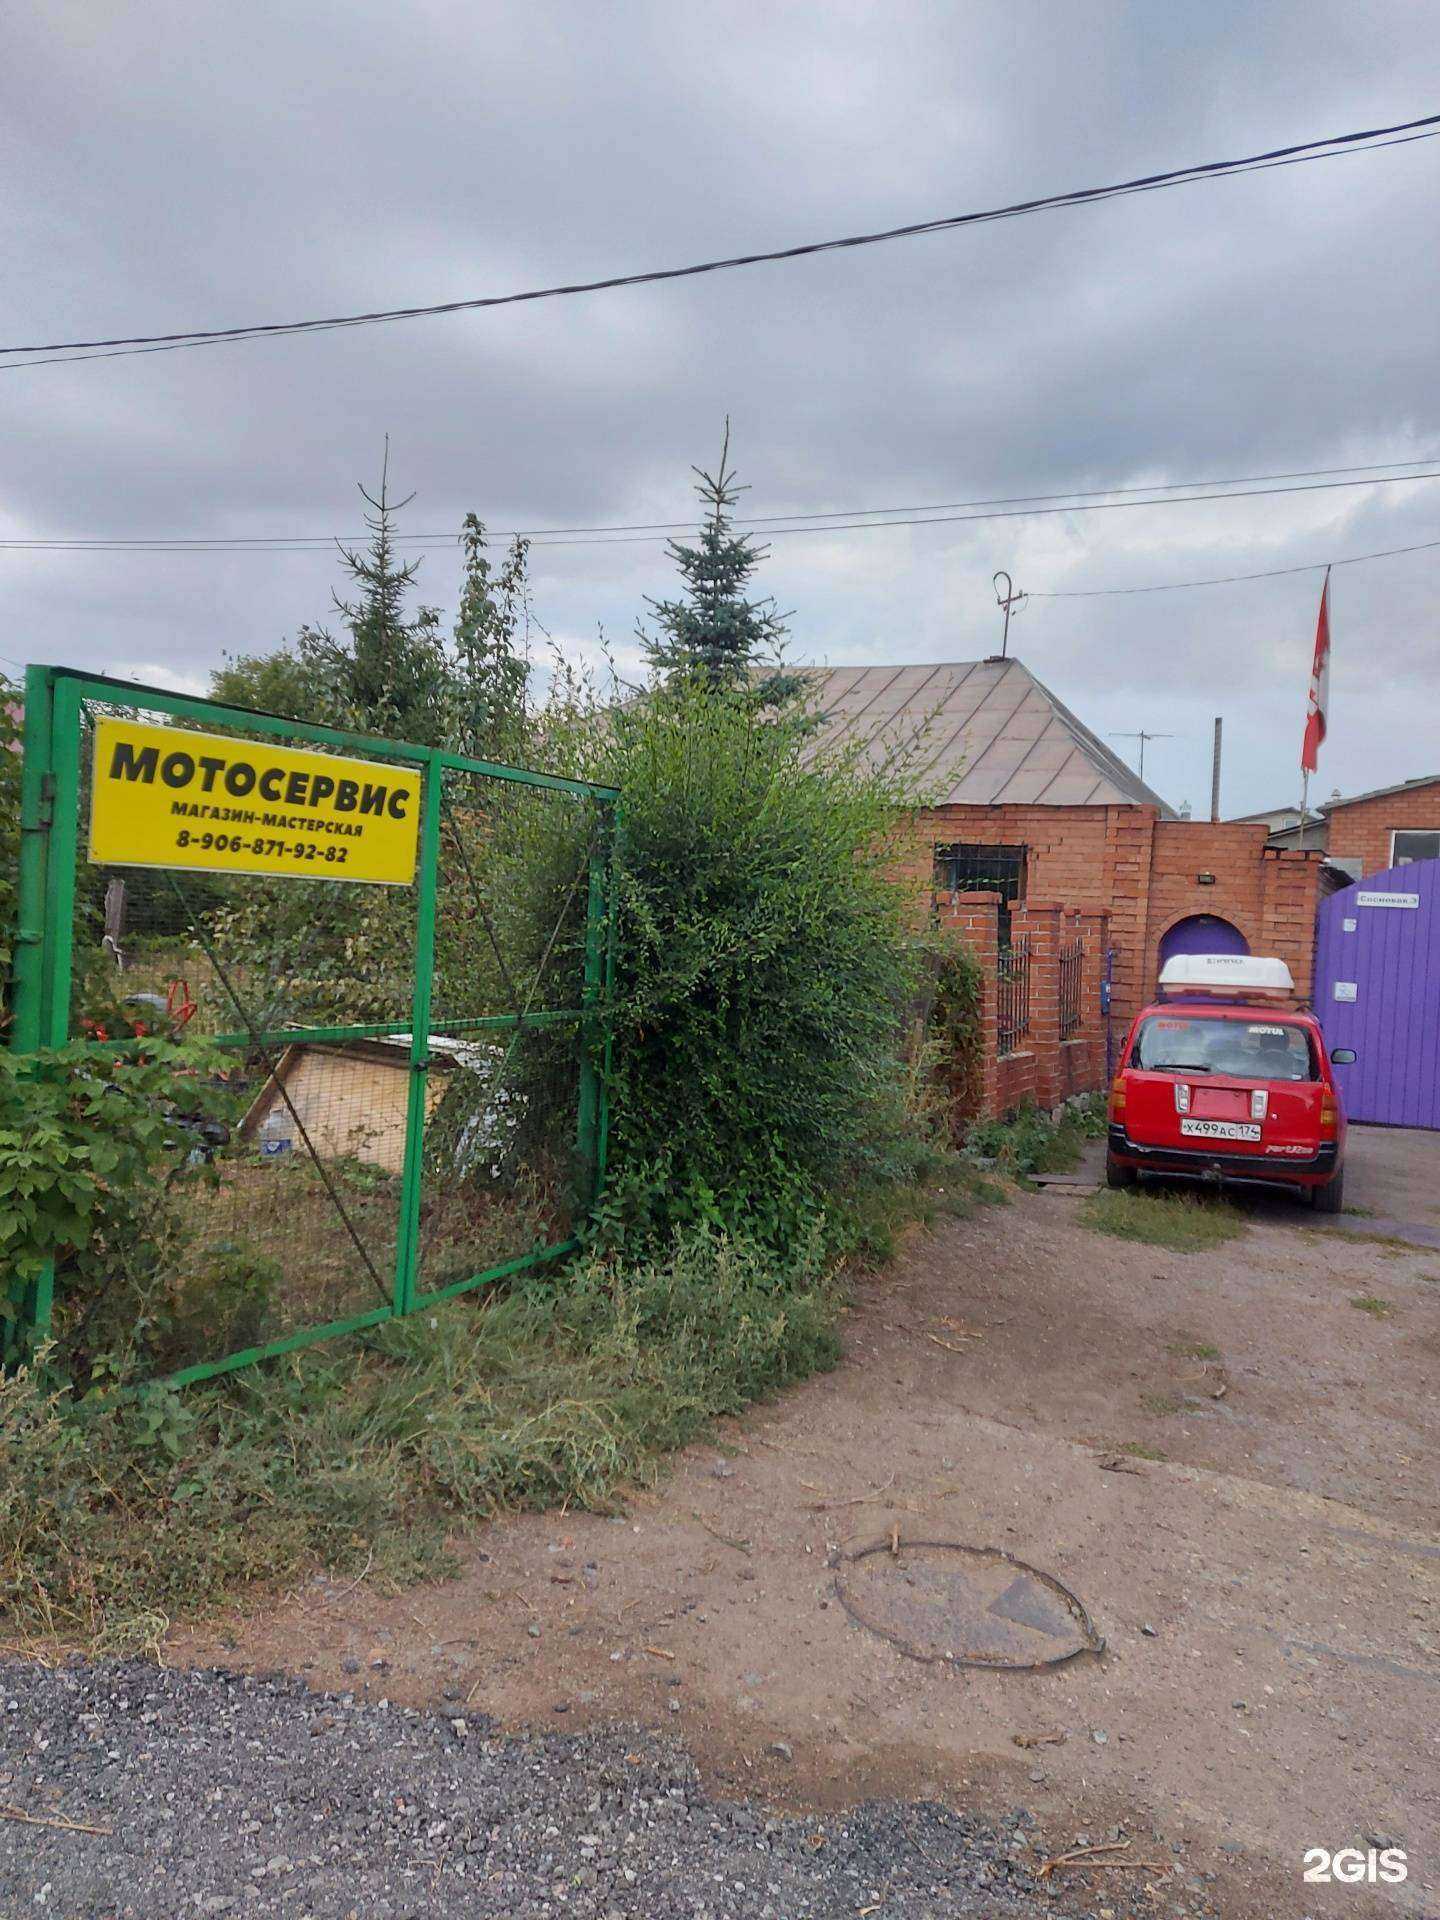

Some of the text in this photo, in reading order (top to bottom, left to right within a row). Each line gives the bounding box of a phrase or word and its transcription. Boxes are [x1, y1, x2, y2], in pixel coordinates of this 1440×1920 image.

[109, 742, 410, 820] МОТОСЕРВИС
[170, 801, 364, 837] МАГАЗИН-МАСТЕРСКАЯ
[176, 830, 348, 863] 8-906-871-92-82
[1248, 1025, 1285, 1036] MOTUL
